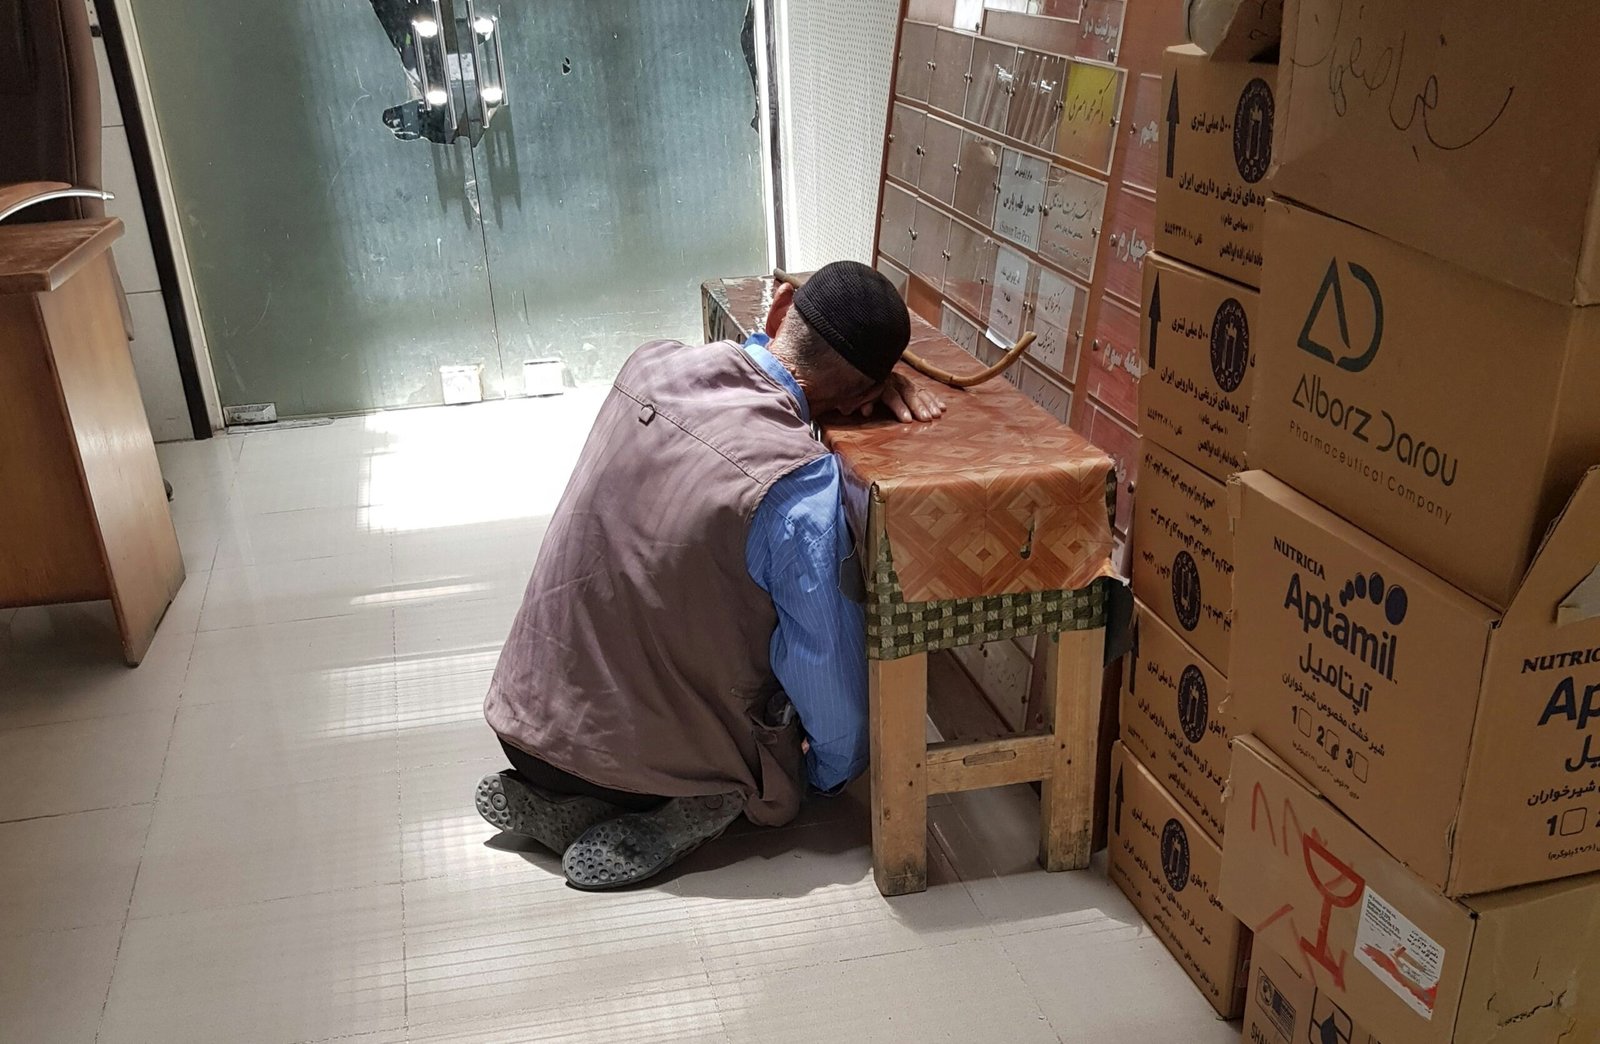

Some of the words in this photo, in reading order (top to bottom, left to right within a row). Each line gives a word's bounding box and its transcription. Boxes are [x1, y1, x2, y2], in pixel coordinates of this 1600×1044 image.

[1179, 171, 1194, 190] ایران
[1194, 178, 1214, 196] دارویی
[1160, 367, 1175, 385] ایران
[1175, 378, 1193, 393] دارویی
[1292, 373, 1372, 443] Alborz
[1376, 410, 1458, 486] Darou
[1290, 420, 1384, 484] Pharmaceutical
[1387, 476, 1452, 525] Company
[1274, 535, 1326, 581] NUTRICIA
[1284, 572, 1397, 684] Aptamil
[1299, 642, 1372, 716] آپتامیل
[1317, 701, 1347, 728] مخصوص
[1292, 705, 1302, 725] 1
[1316, 726, 1325, 748] 2
[1346, 748, 1354, 769] 3
[1347, 722, 1368, 743] خشک
[1368, 742, 1386, 758] شیر
[1547, 816, 1558, 836] 1
